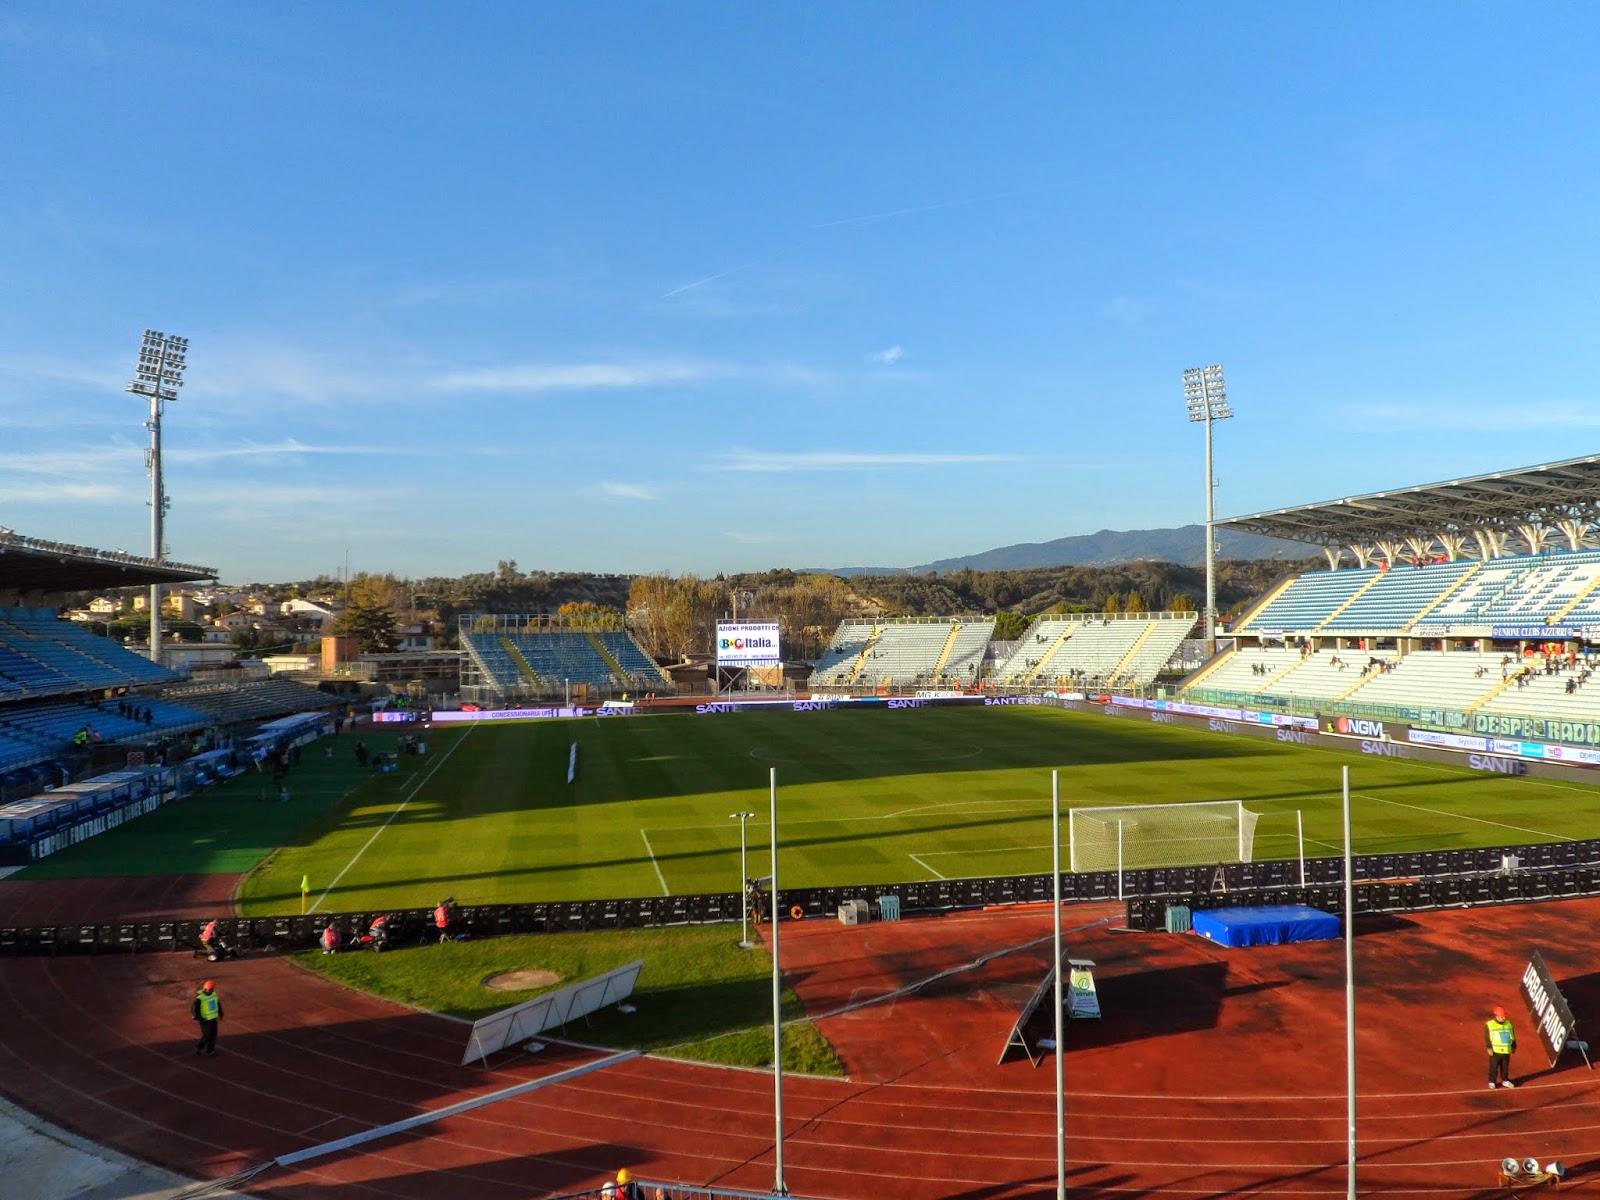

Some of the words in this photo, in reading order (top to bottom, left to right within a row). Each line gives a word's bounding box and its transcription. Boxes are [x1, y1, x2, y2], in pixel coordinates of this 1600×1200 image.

[1499, 627, 1520, 638] UNIONE
[1521, 627, 1539, 637] CLUBS
[1541, 627, 1567, 637] AZZURRI
[745, 637, 771, 648] Italia
[984, 697, 1041, 706] SANTERO
[1348, 719, 1383, 737] NGM
[1523, 961, 1549, 1017] URBAN
[1542, 1003, 1566, 1053] RING
